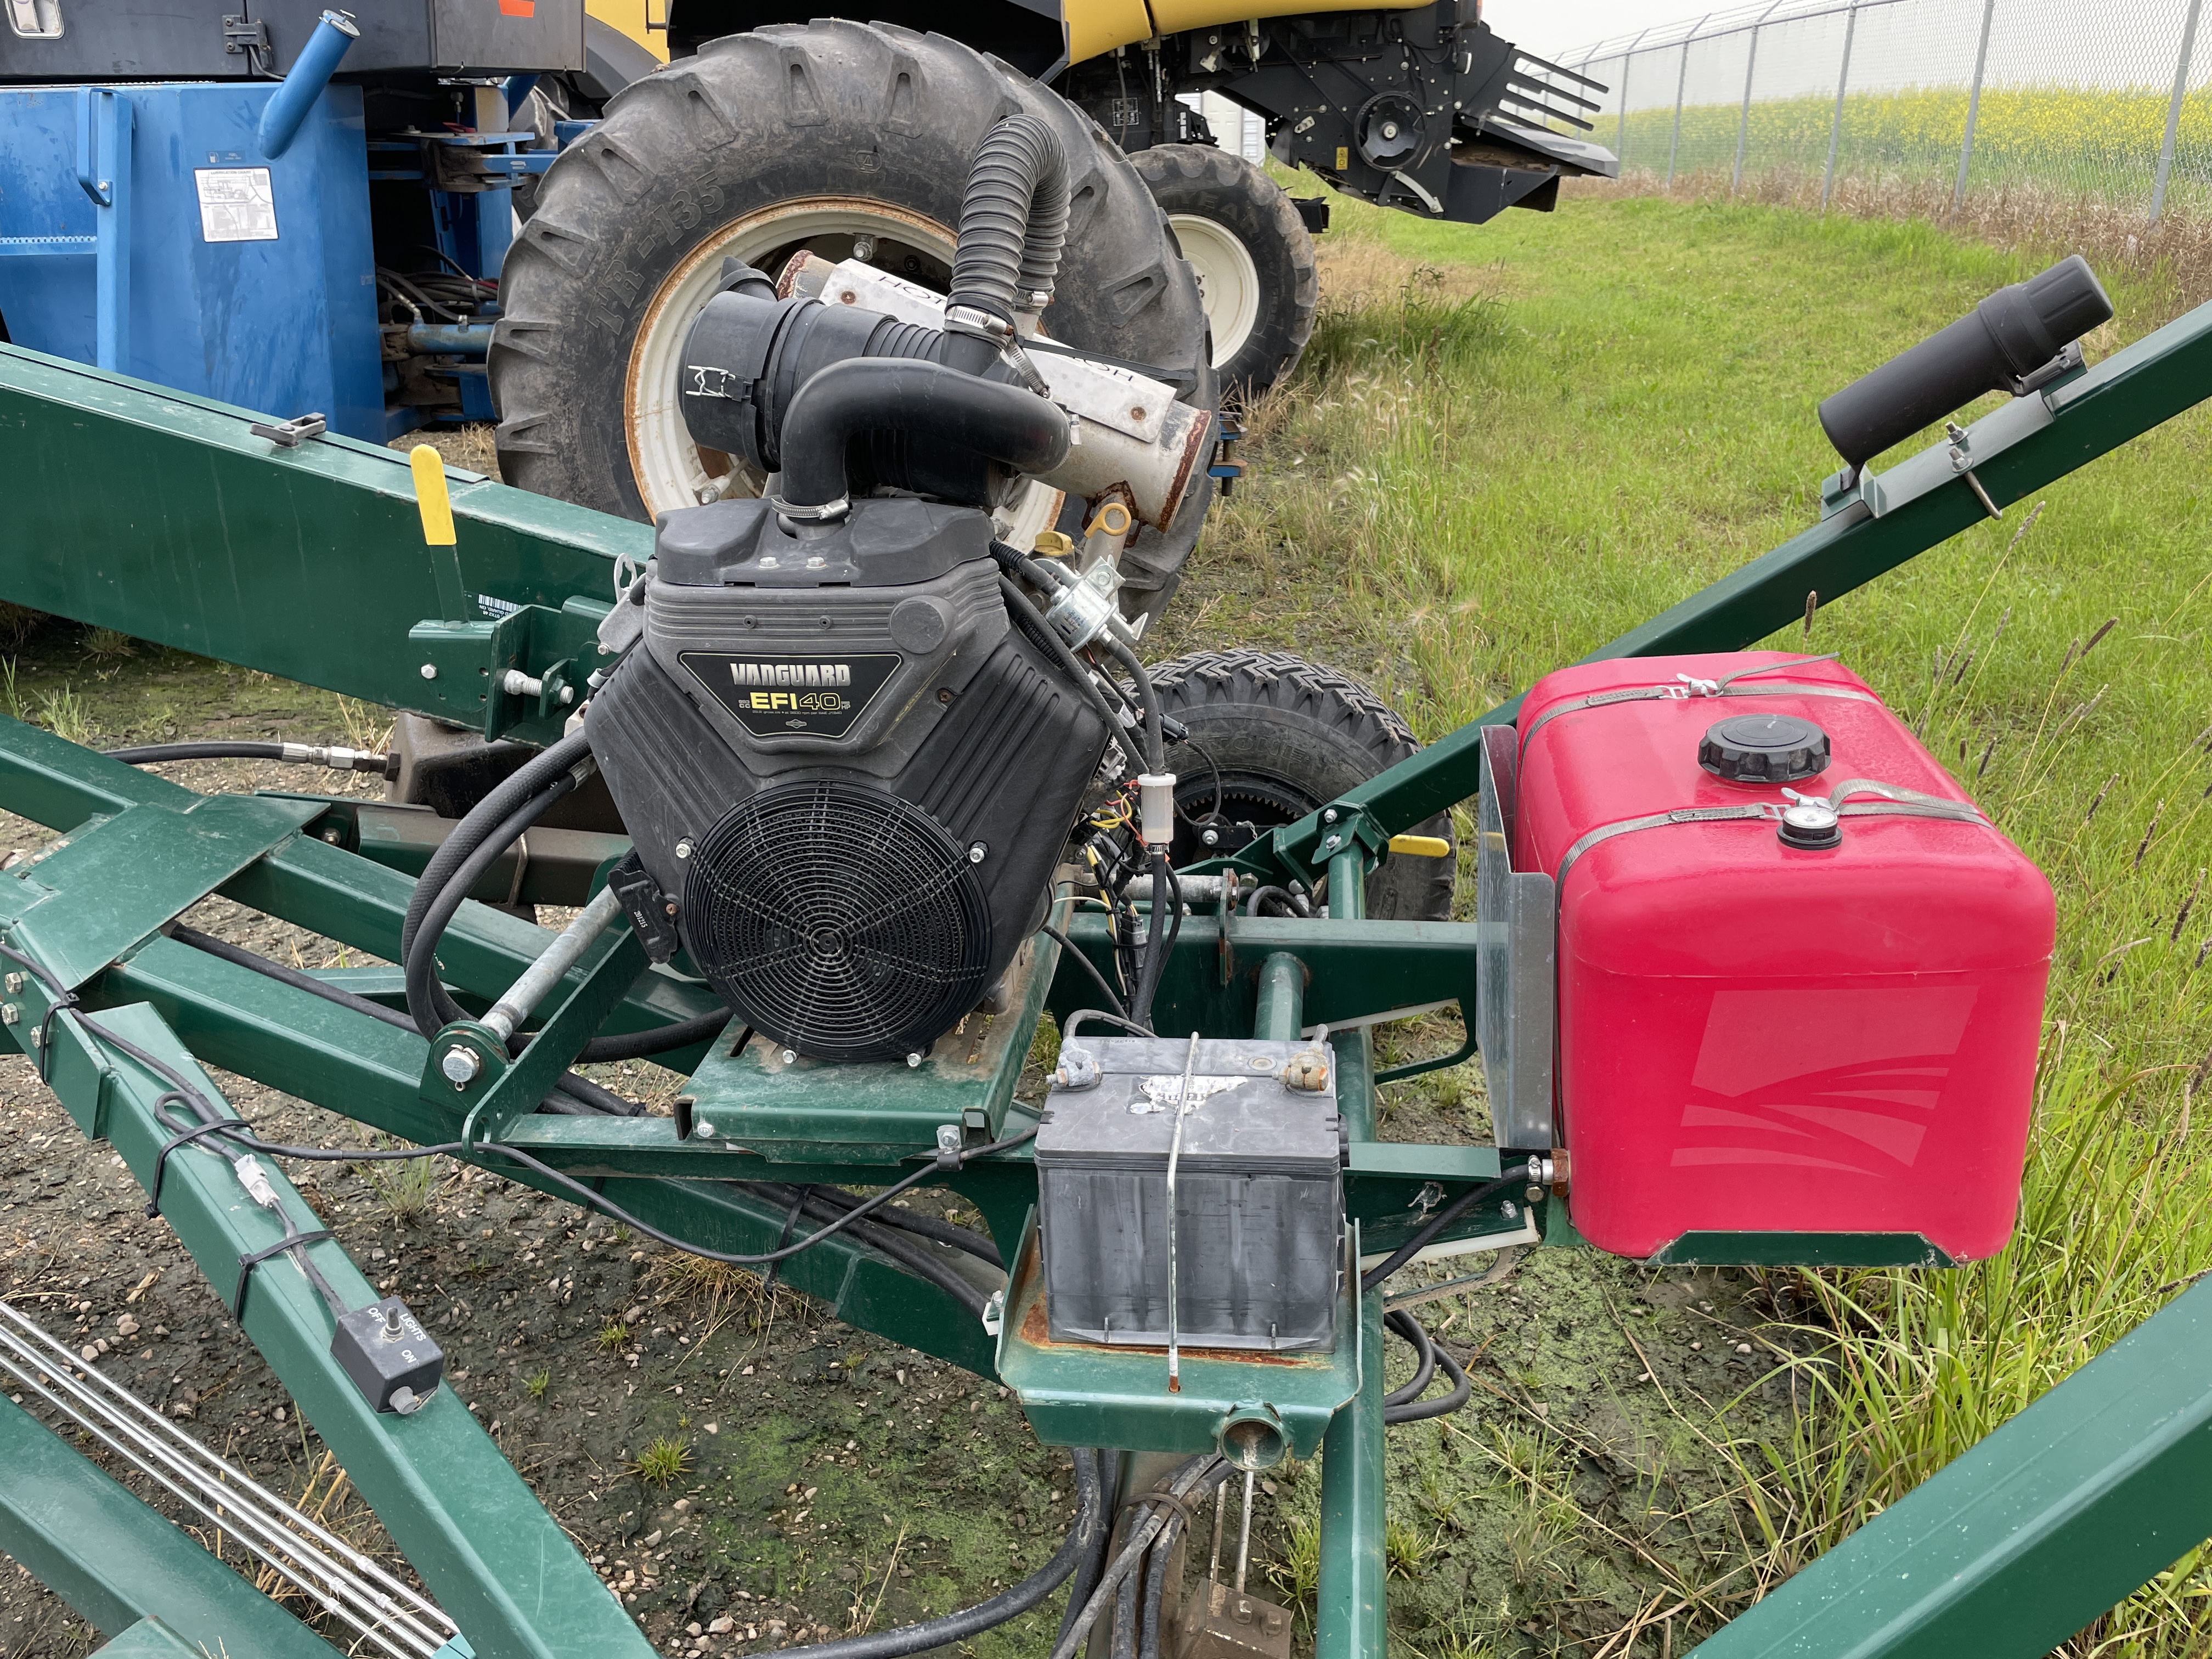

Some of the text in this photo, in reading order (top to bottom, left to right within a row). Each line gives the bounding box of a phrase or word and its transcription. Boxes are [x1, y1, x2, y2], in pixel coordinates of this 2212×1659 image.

[878, 276, 947, 304] HOT
[729, 663, 851, 686] VANGUARD
[634, 910, 648, 928] 201215
[368, 1307, 386, 1323] OFF
[399, 1313, 426, 1341] LIGHTS
[402, 1350, 417, 1363] ON
